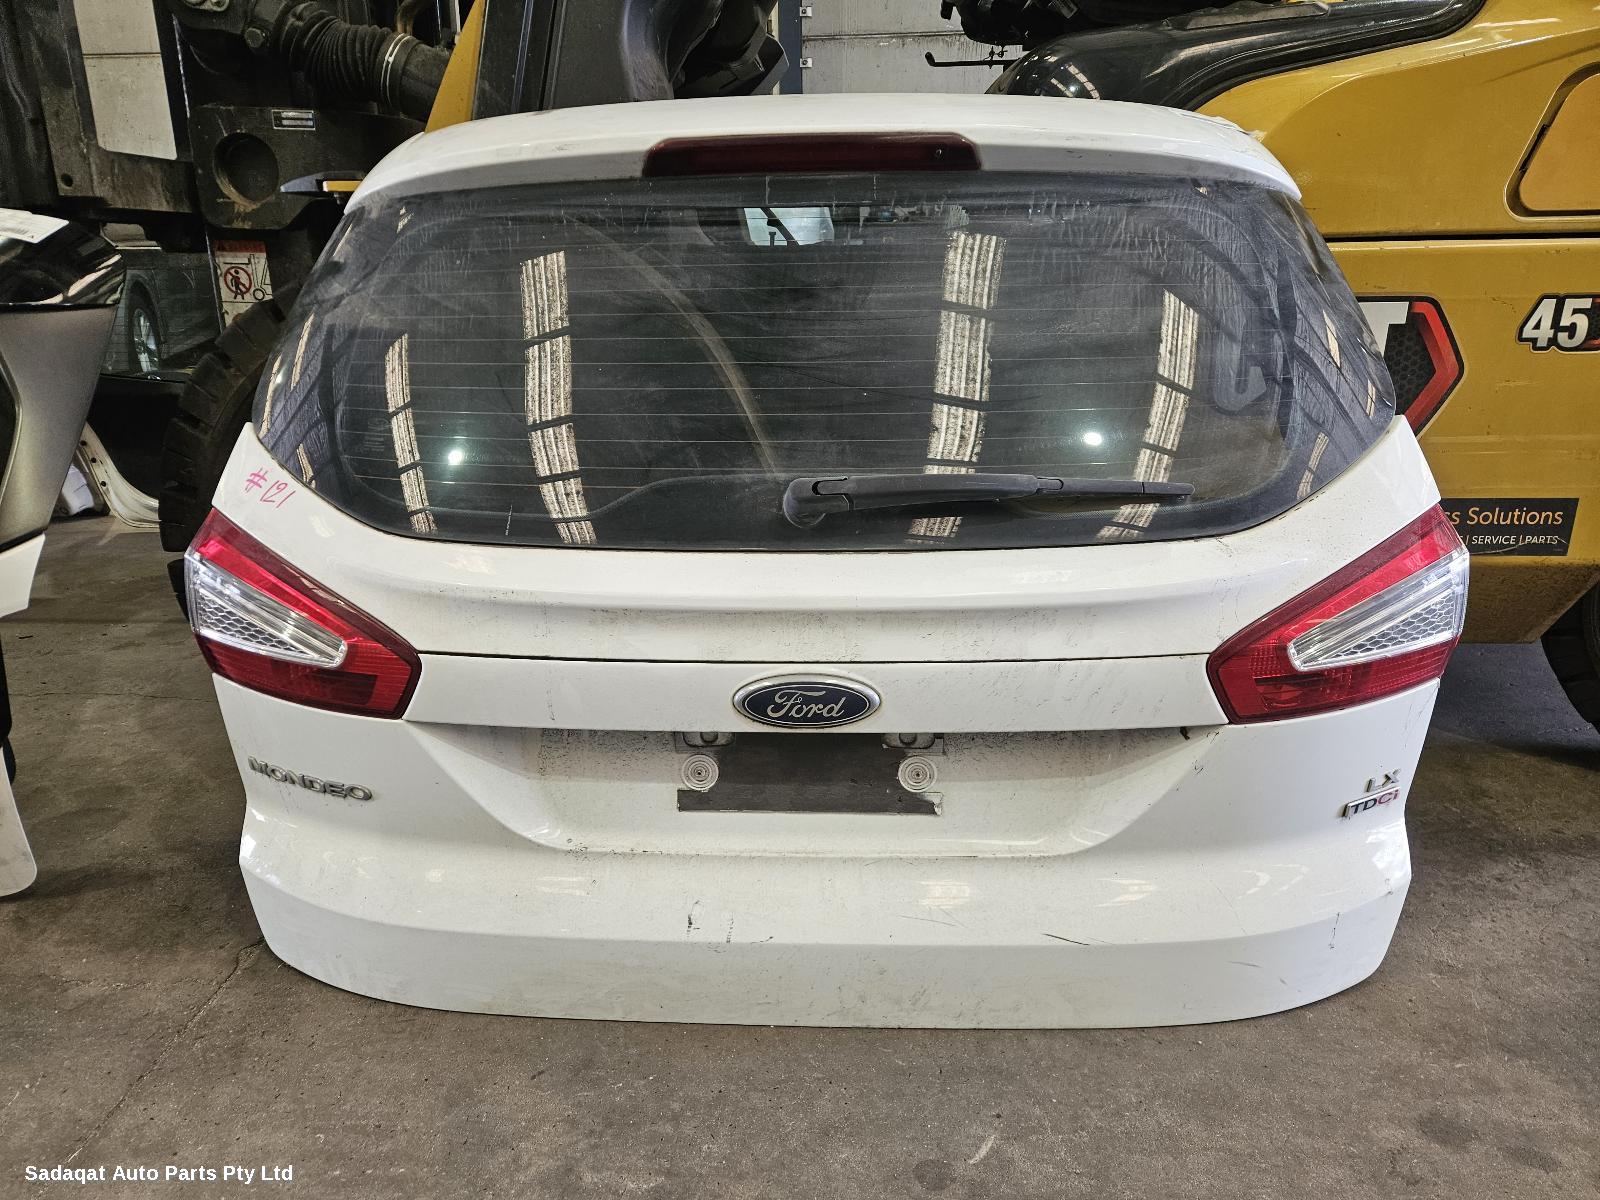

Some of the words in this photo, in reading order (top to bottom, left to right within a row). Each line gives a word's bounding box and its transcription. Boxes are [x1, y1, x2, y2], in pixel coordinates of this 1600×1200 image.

[1521, 297, 1593, 348] 45
[1466, 506, 1564, 526] Solutions
[1471, 534, 1517, 546] SERVICE
[1524, 535, 1559, 546] PARTS
[766, 689, 847, 719] Ford
[247, 755, 373, 801] MONDEO
[1363, 768, 1401, 793] LX
[1348, 788, 1400, 815] TDCi
